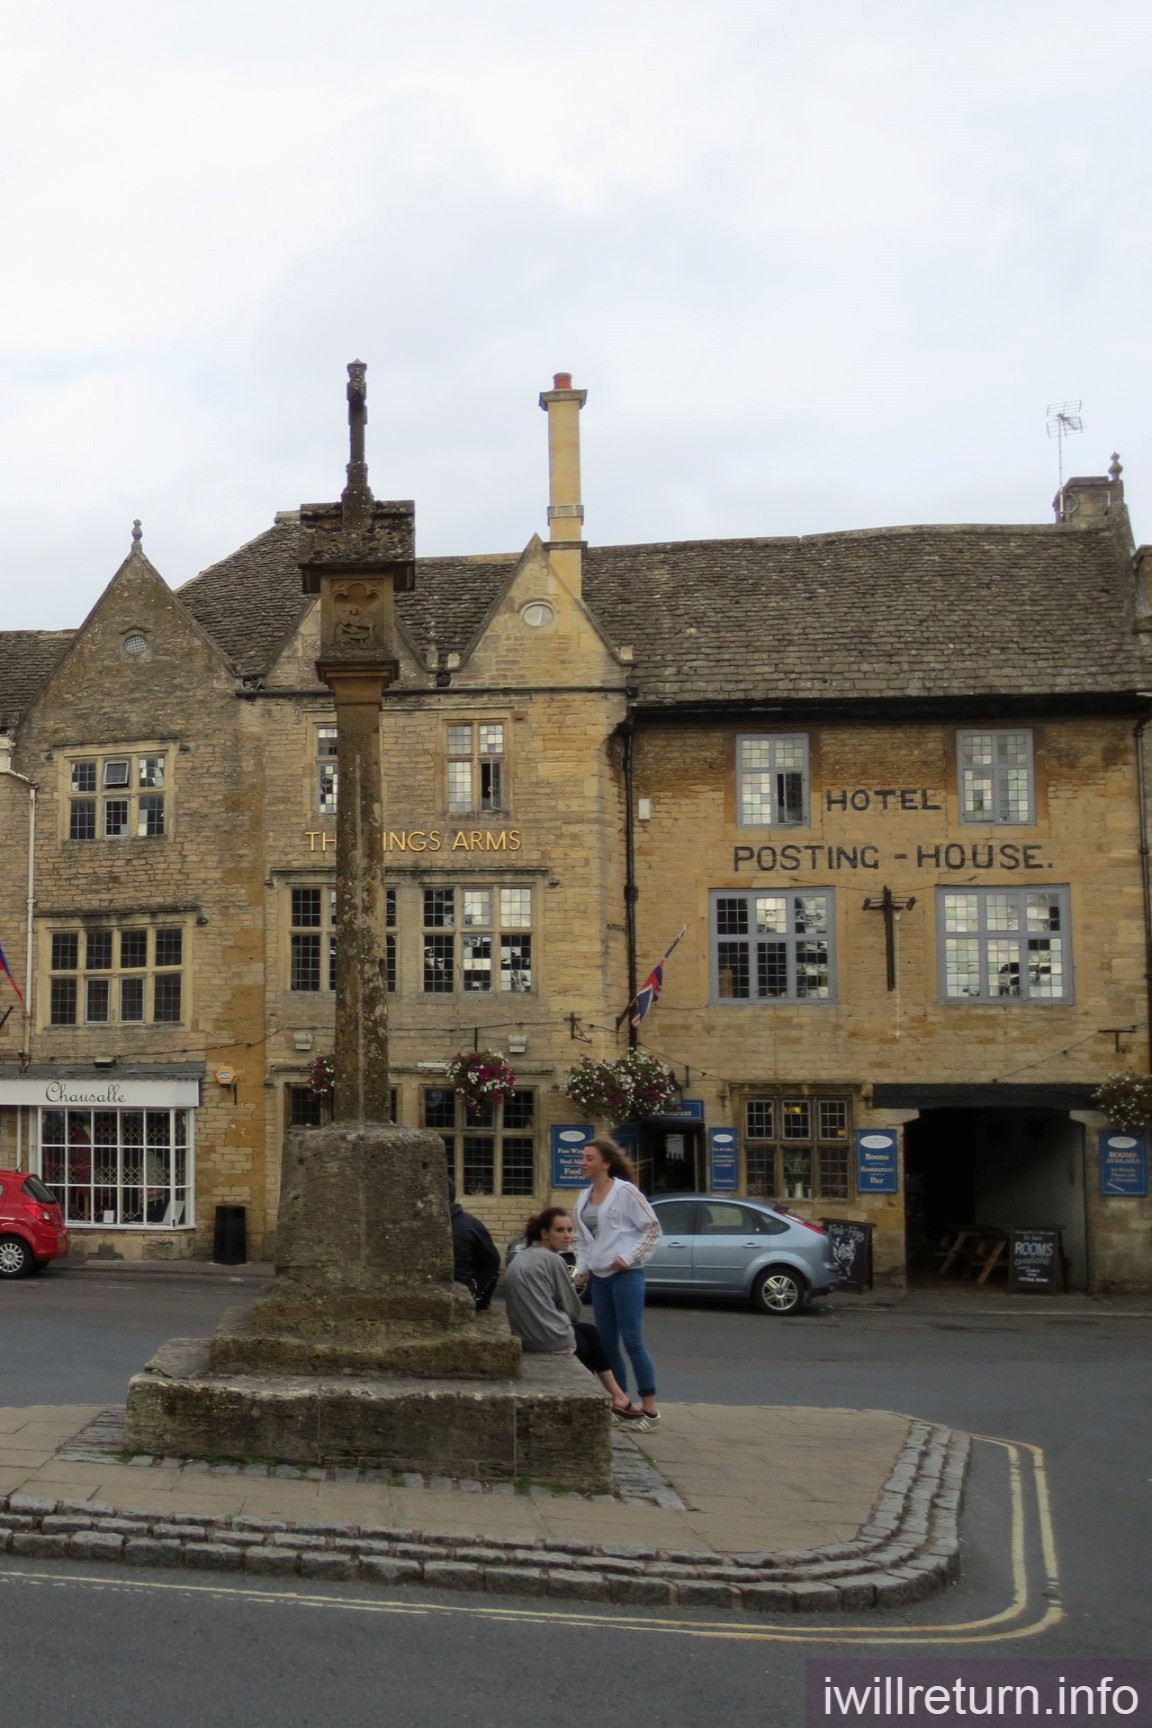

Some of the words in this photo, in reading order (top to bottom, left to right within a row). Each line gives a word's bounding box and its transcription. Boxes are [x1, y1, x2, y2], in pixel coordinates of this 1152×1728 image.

[826, 788, 942, 812] HOTEL
[304, 831, 336, 851] TH
[382, 830, 441, 852] INGS
[451, 830, 521, 852] ARMS
[733, 844, 880, 872] POSTING
[916, 843, 1054, 871] HOUSE.
[45, 1081, 127, 1103] Chausalle
[864, 1152, 890, 1161] Rooms
[564, 1167, 582, 1175] Food
[870, 1176, 885, 1184] Bar
[1014, 1241, 1055, 1257] ROOMS
